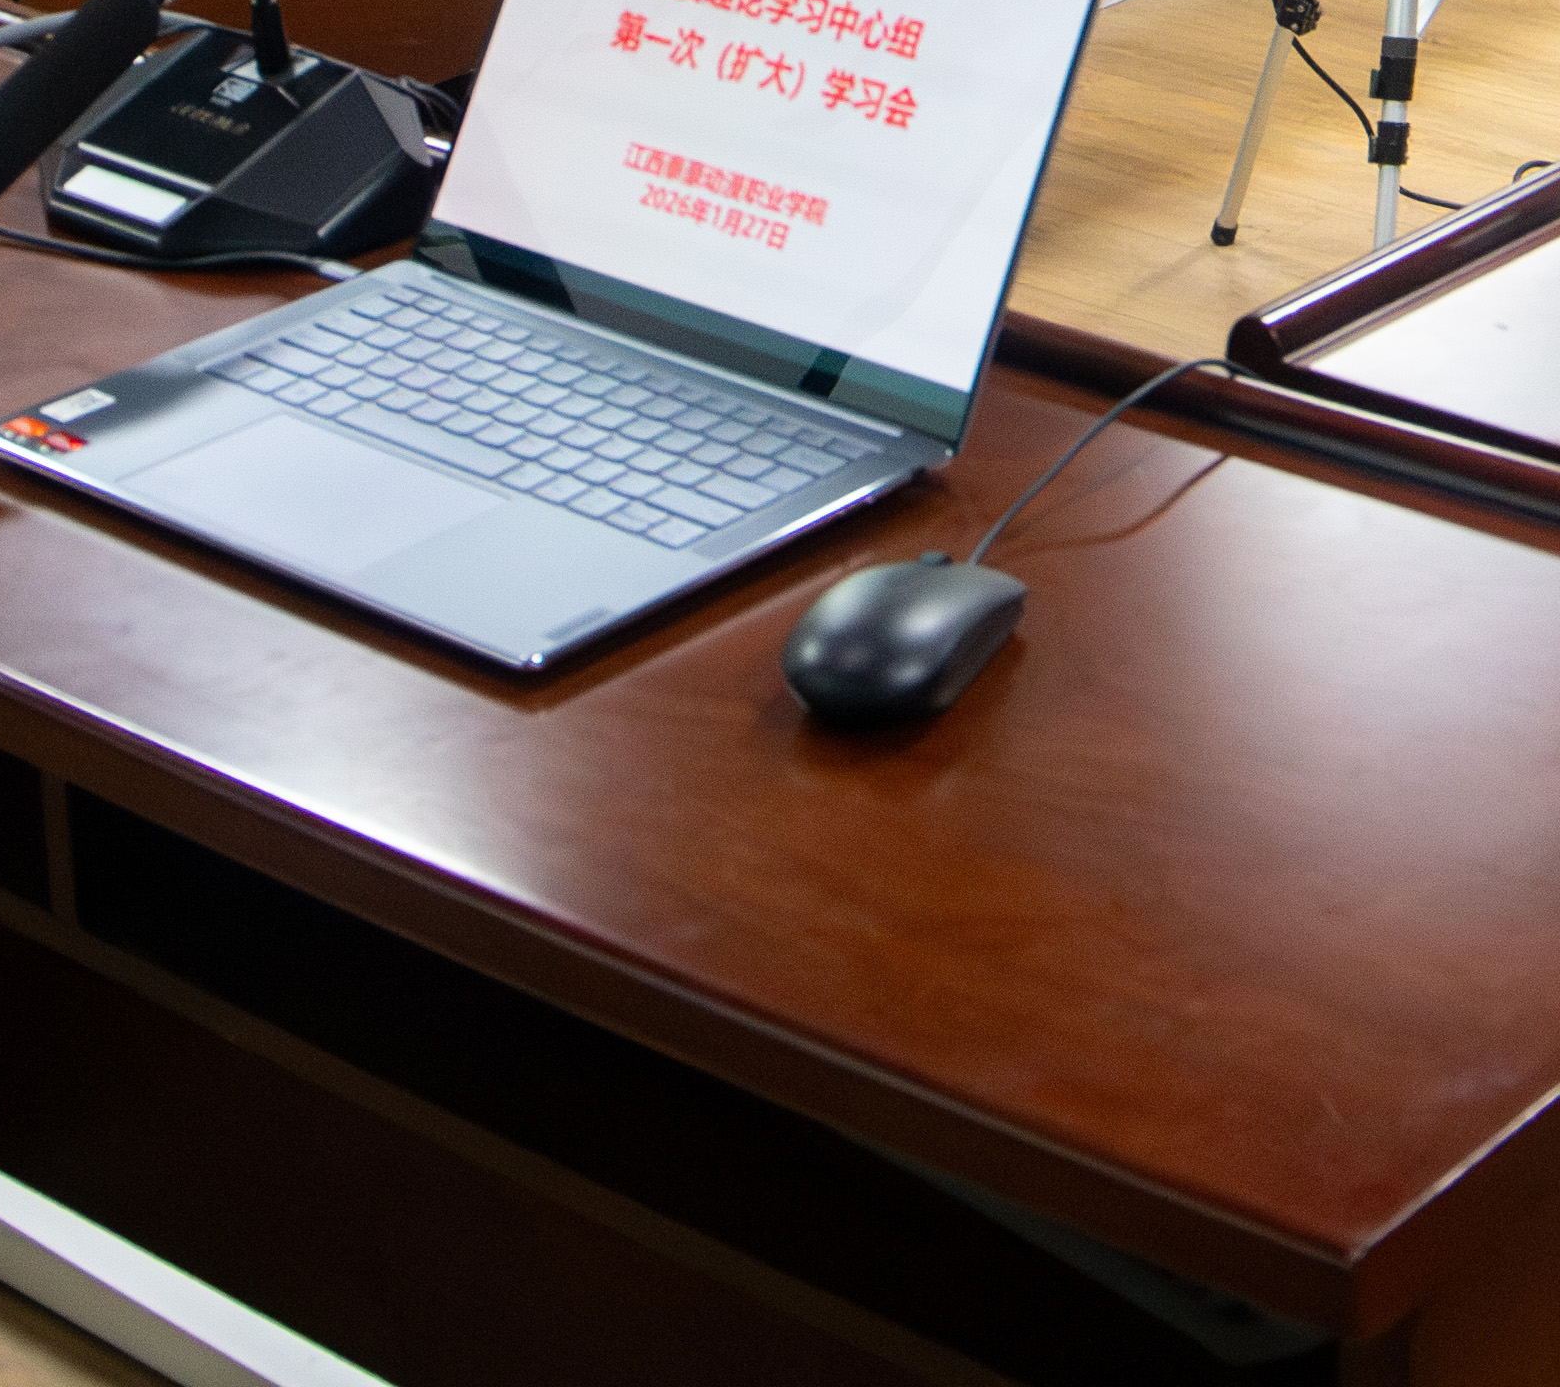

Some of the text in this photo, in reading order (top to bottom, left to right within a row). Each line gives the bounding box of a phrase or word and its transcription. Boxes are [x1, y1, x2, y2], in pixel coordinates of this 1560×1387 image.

[622, 140, 830, 228] 江西泰豪动漫职业学院
[639, 182, 791, 251] 2026年1月27日
